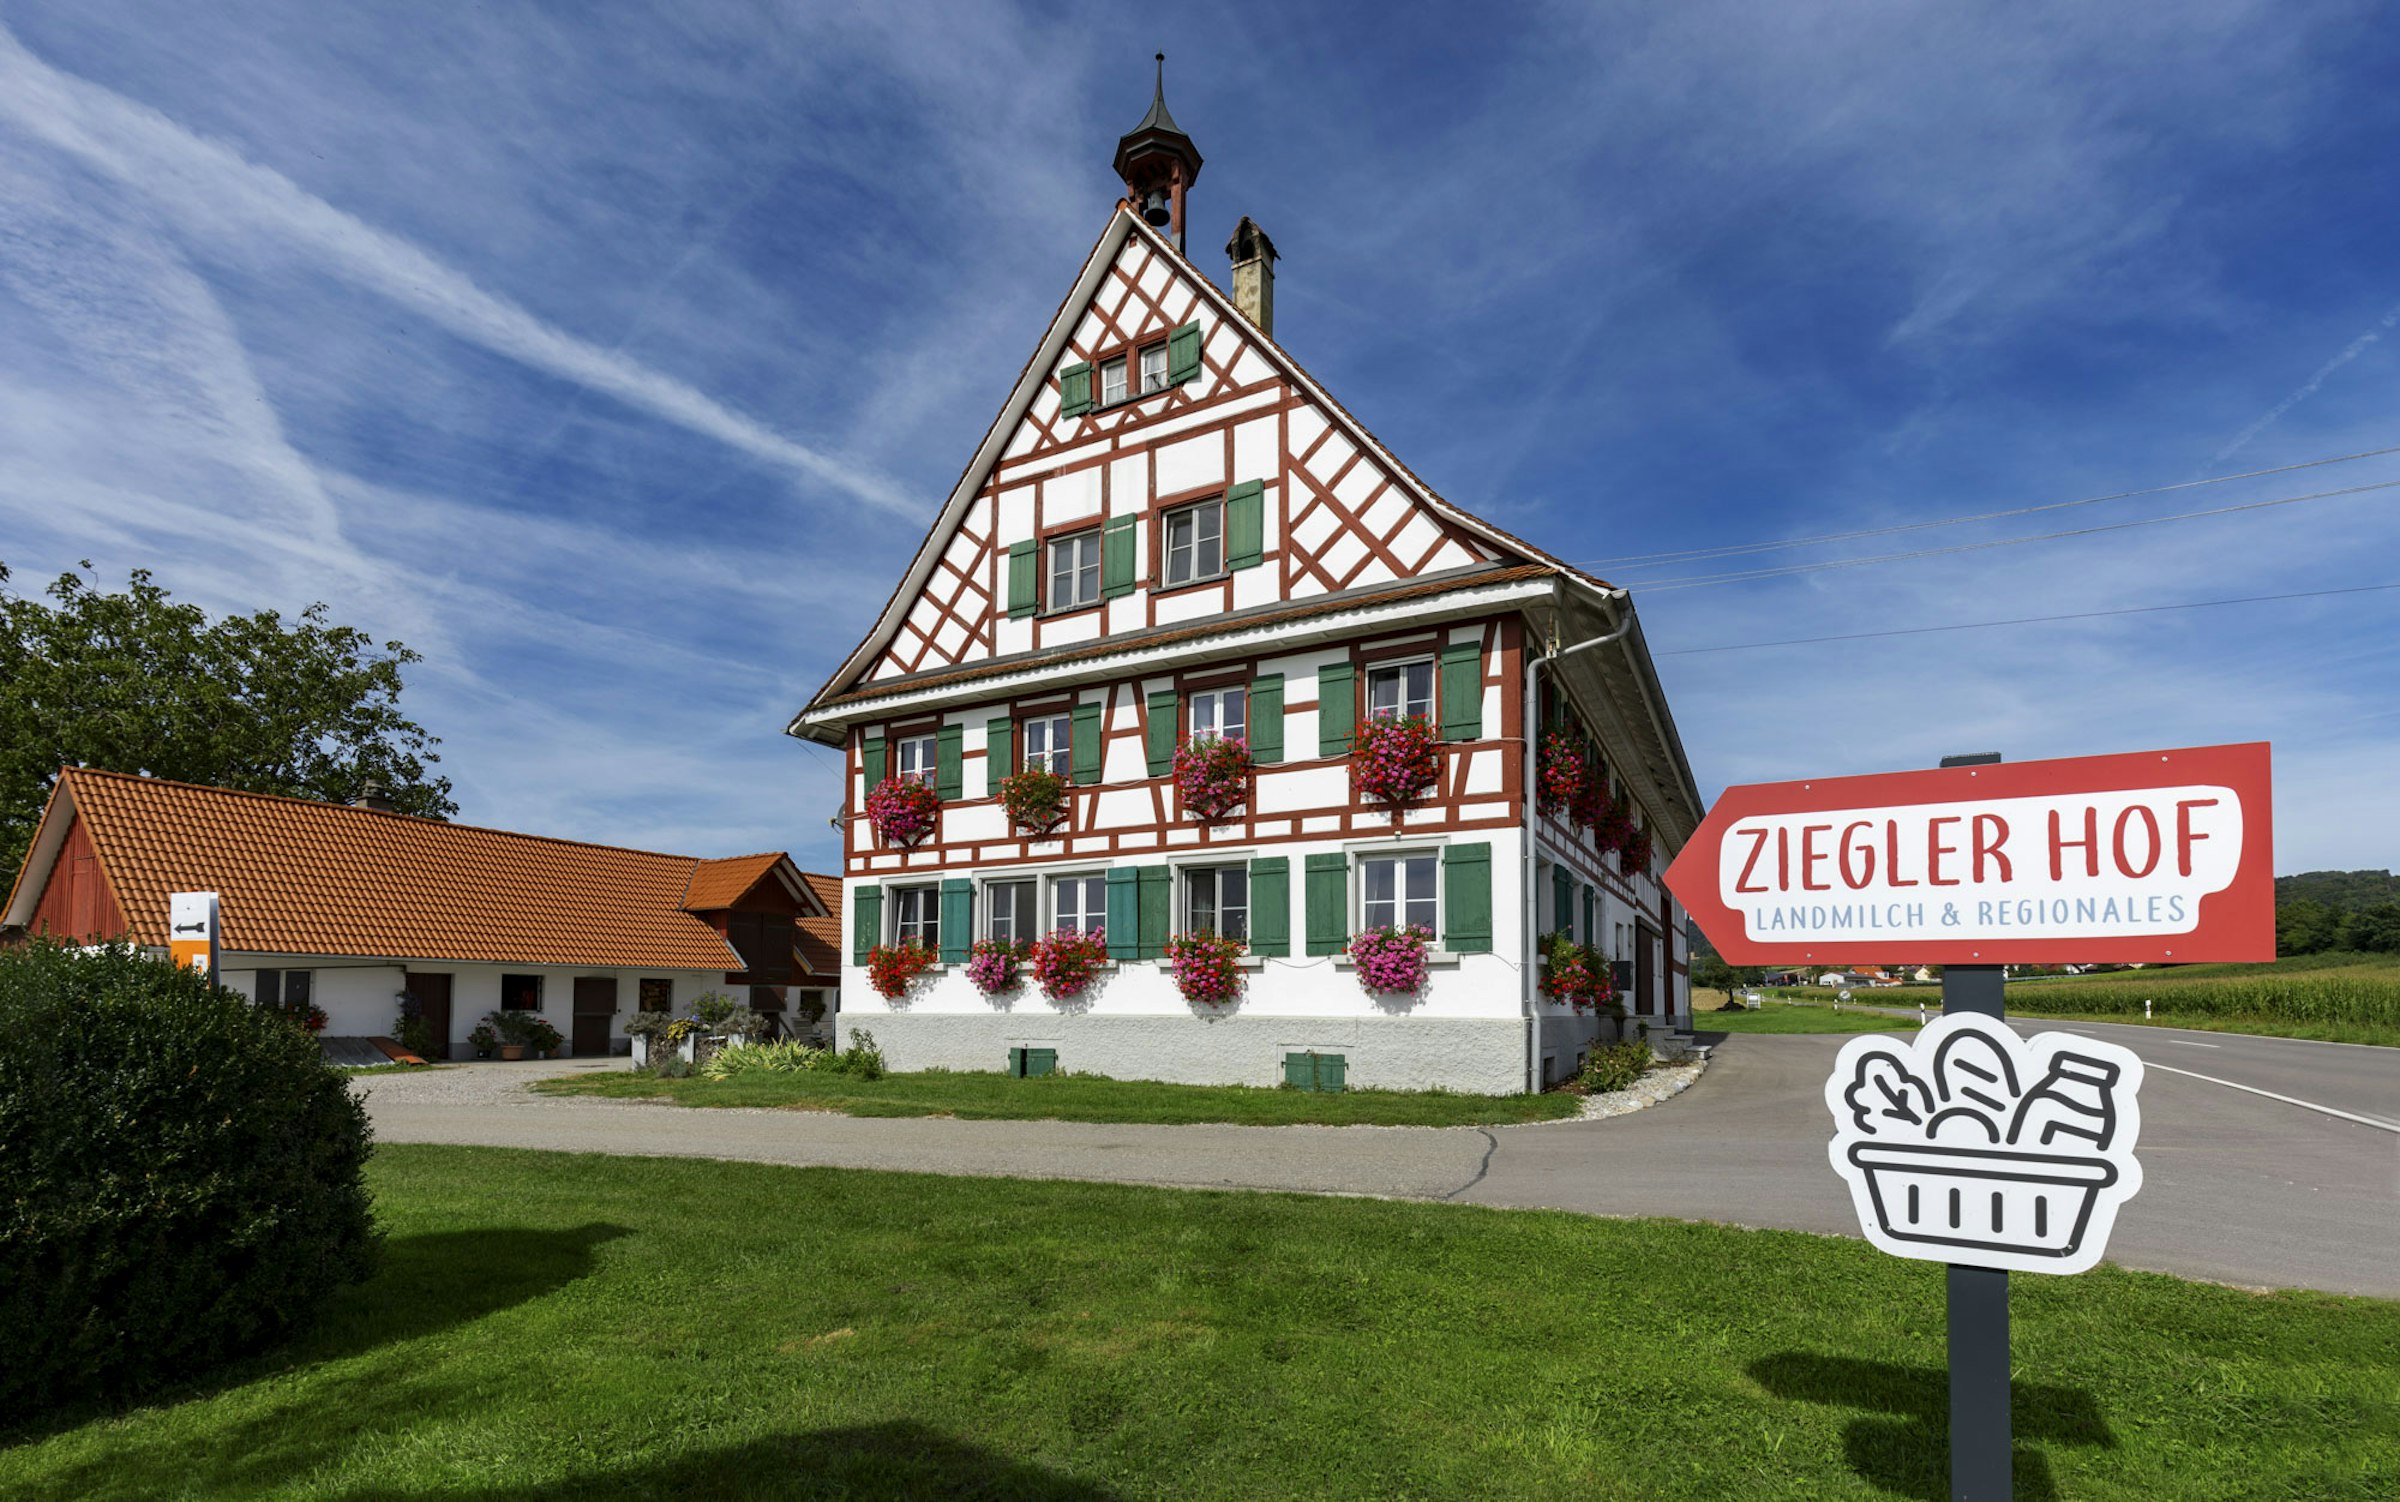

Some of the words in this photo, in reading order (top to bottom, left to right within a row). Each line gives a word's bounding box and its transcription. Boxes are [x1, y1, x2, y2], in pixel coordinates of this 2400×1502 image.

[1736, 814, 2012, 893] ZIEGLER
[2048, 799, 2219, 881] HOF
[1757, 904, 1924, 931] LANDMILCH
[1940, 902, 1961, 926] &
[1978, 895, 2186, 925] REGIONALES
